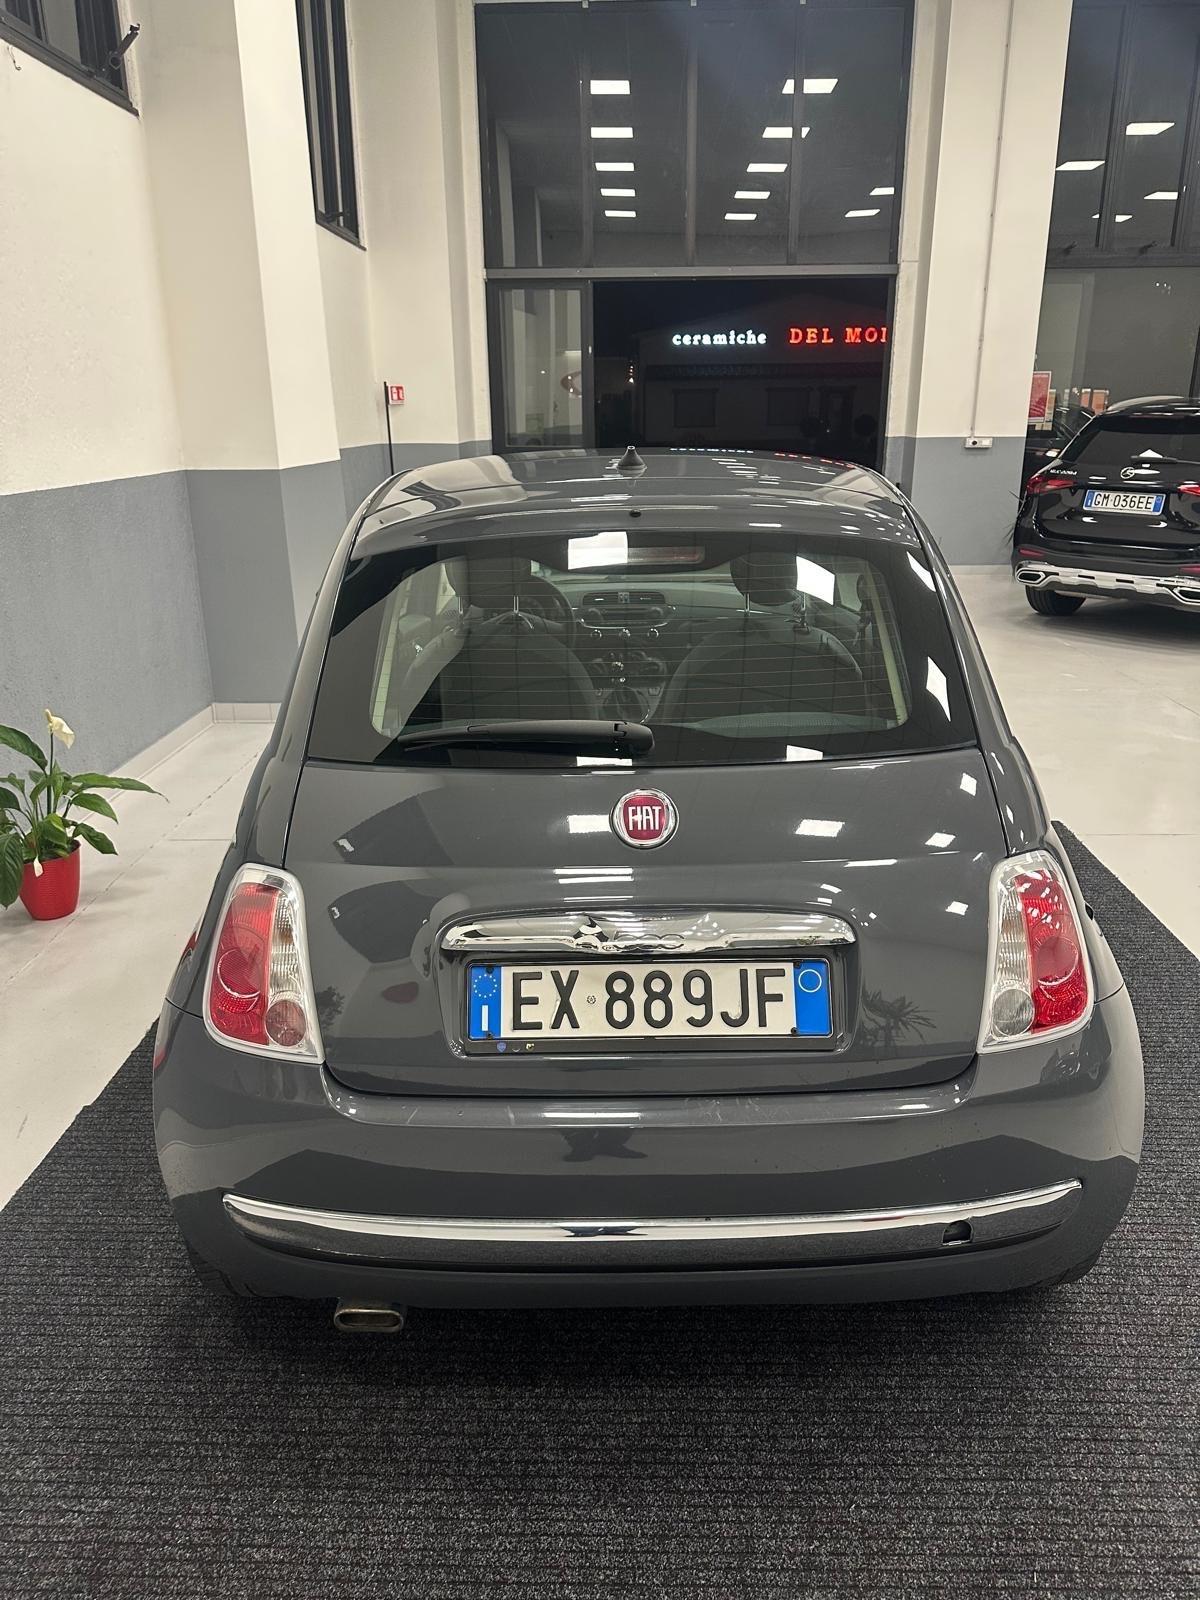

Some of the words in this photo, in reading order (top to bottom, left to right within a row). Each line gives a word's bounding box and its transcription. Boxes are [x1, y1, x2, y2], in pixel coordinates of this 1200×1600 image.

[671, 329, 768, 346] ceramiche
[789, 327, 834, 344] DEL
[1093, 493, 1111, 507] GM
[1112, 494, 1155, 510] 036EE
[627, 805, 662, 831] FIAT
[512, 969, 580, 1031] EX
[604, 968, 786, 1029] 889JF
